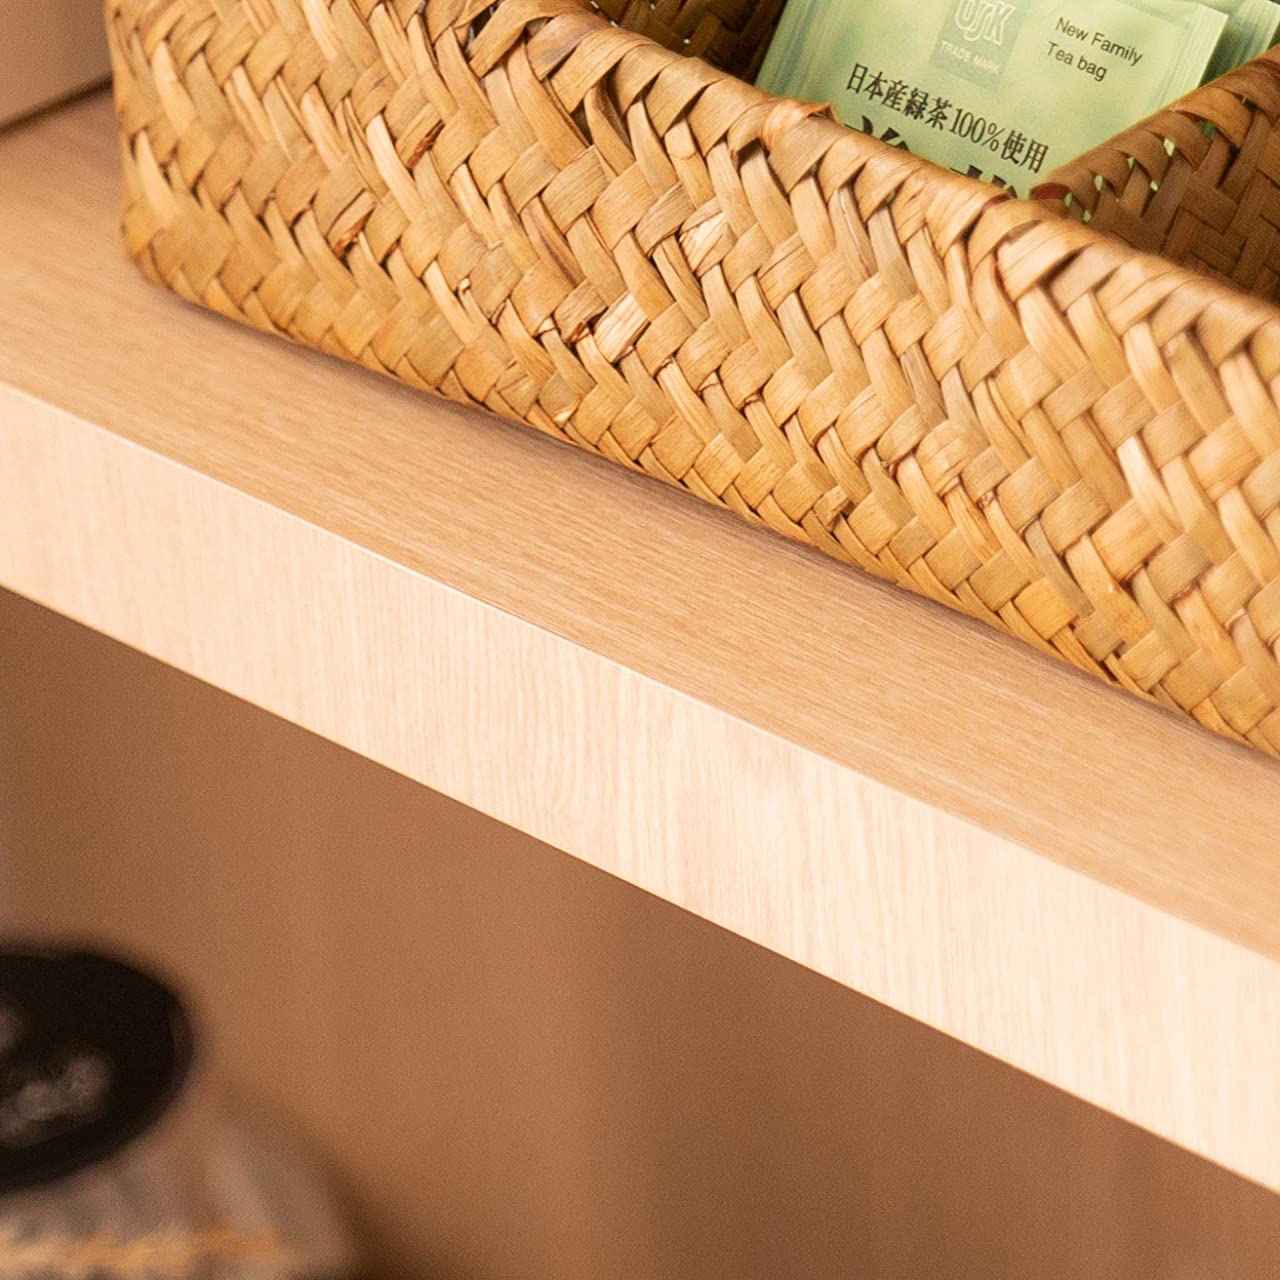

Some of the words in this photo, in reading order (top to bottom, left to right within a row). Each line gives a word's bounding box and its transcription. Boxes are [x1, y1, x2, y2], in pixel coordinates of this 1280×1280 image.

[939, 40, 972, 64] TRADE
[973, 52, 1001, 75] MARK
[1047, 41, 1074, 66] Tea
[1076, 54, 1108, 83] bag
[1055, 17, 1089, 43] New
[1091, 31, 1143, 68] Family
